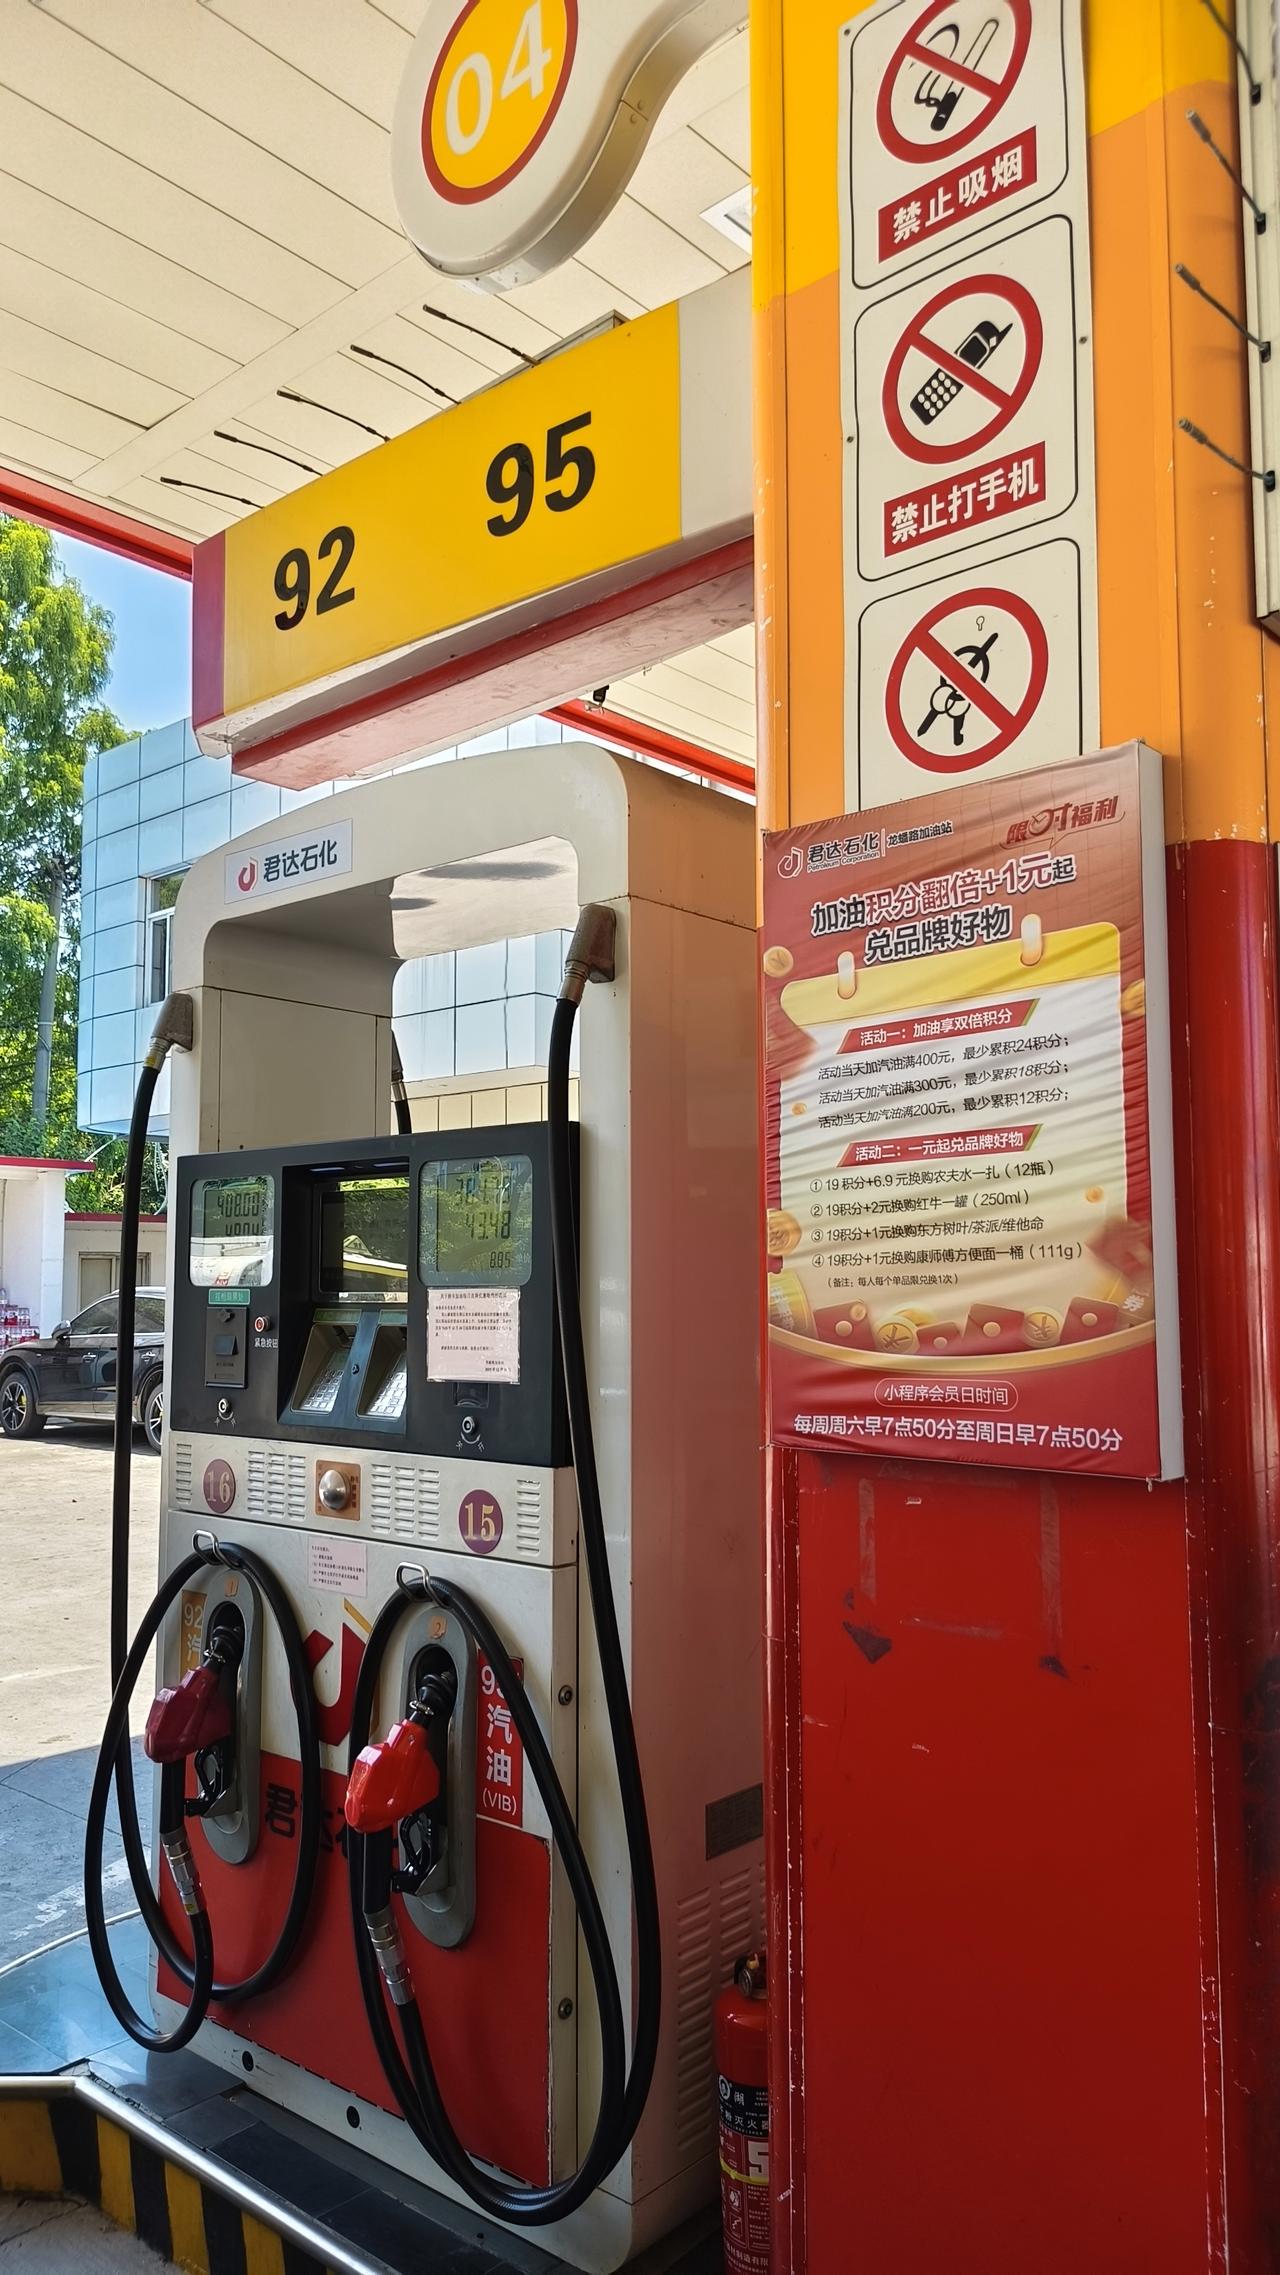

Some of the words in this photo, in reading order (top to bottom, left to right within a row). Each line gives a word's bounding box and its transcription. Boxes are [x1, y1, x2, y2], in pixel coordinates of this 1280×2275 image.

[446, 0, 552, 156] 04
[892, 144, 1023, 245] 禁止吸烟
[486, 411, 596, 537] 95
[891, 457, 1039, 544] 禁止打手机
[274, 526, 355, 631] 92
[808, 832, 879, 863] 君达石化
[887, 821, 953, 848] 龙蟠路加油站
[263, 839, 337, 882] 君达石化
[808, 860, 840, 873] Petroleum
[842, 851, 880, 866] Corporation
[811, 851, 1077, 936] 加油积分翻倍+1元起
[864, 905, 1013, 965] 兑品牌好物
[860, 1008, 1013, 1047] 活动一：加油享双倍积分
[855, 1133, 1024, 1161] 活动二：一元起兑品牌好物
[217, 1191, 260, 1218] 408.00
[883, 1383, 1009, 1405] 小程序会员日时间
[793, 1414, 1123, 1451] 每周周六早7点50分至周日早7点50分
[207, 1468, 231, 1504] 16
[464, 1502, 496, 1541] 15
[184, 1603, 204, 1629] 92
